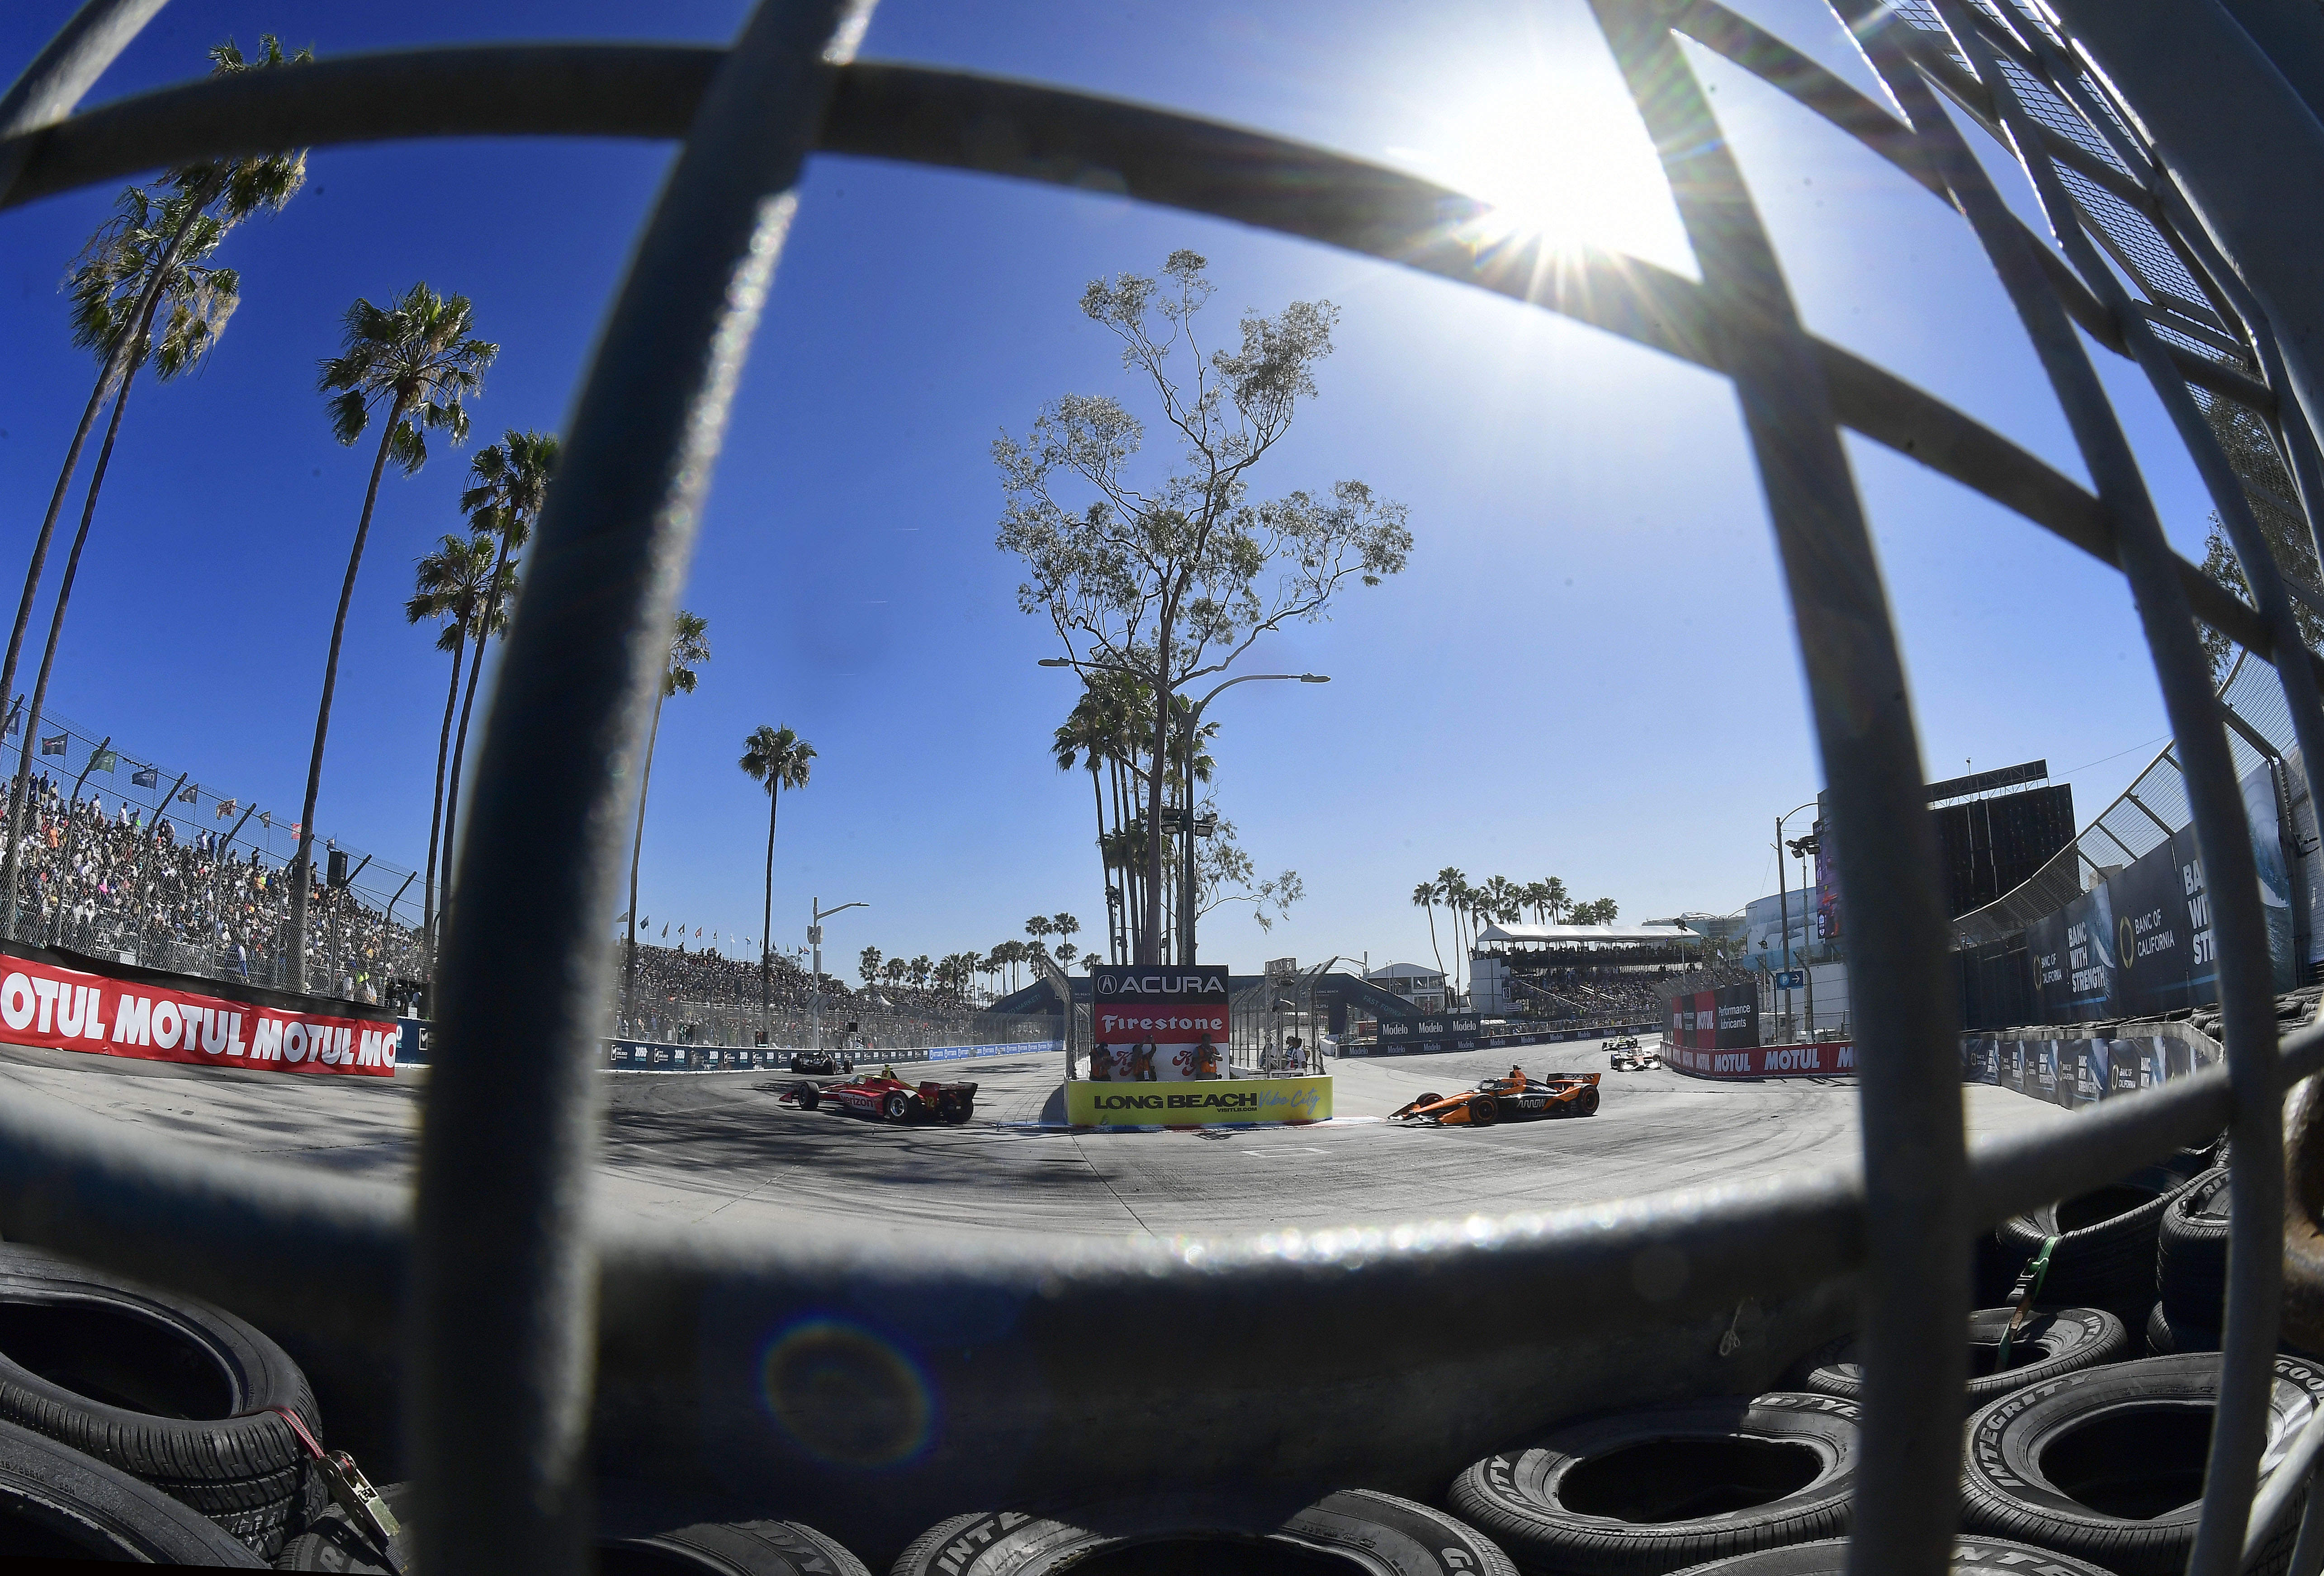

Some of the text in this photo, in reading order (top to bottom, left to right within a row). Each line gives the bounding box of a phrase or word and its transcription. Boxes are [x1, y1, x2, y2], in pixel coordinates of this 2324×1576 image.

[2135, 908, 2162, 935] BANC OF
[2068, 921, 2087, 948] BANC
[2137, 930, 2175, 958] CALIFORNIA
[2041, 953, 2056, 969] BANC OF
[2070, 945, 2087, 970] WITH
[1119, 976, 1225, 993] ACURA
[2072, 965, 2106, 993] STRENGTH
[1504, 988, 1509, 998] 18
[1696, 1010, 1714, 1029] MOTUL
[1718, 1004, 1751, 1016] Performance
[112, 993, 246, 1056] MOTUL
[250, 1017, 355, 1066] MOTUL
[1102, 1014, 1222, 1033] Firestone
[1383, 1020, 1476, 1035] Modelo Modelo Modelo
[1349, 1047, 1368, 1055] Modelo
[1424, 1043, 1440, 1051] Modelo
[1714, 1053, 1751, 1072] MOTUL
[1764, 1048, 1820, 1070] MOTUL
[842, 1095, 873, 1108] verizon
[1094, 1088, 1321, 1114] LONG BEACH Vibe City
[1517, 1099, 1546, 1108] ARROW
[1979, 1373, 2092, 1486] INTEGRITY
